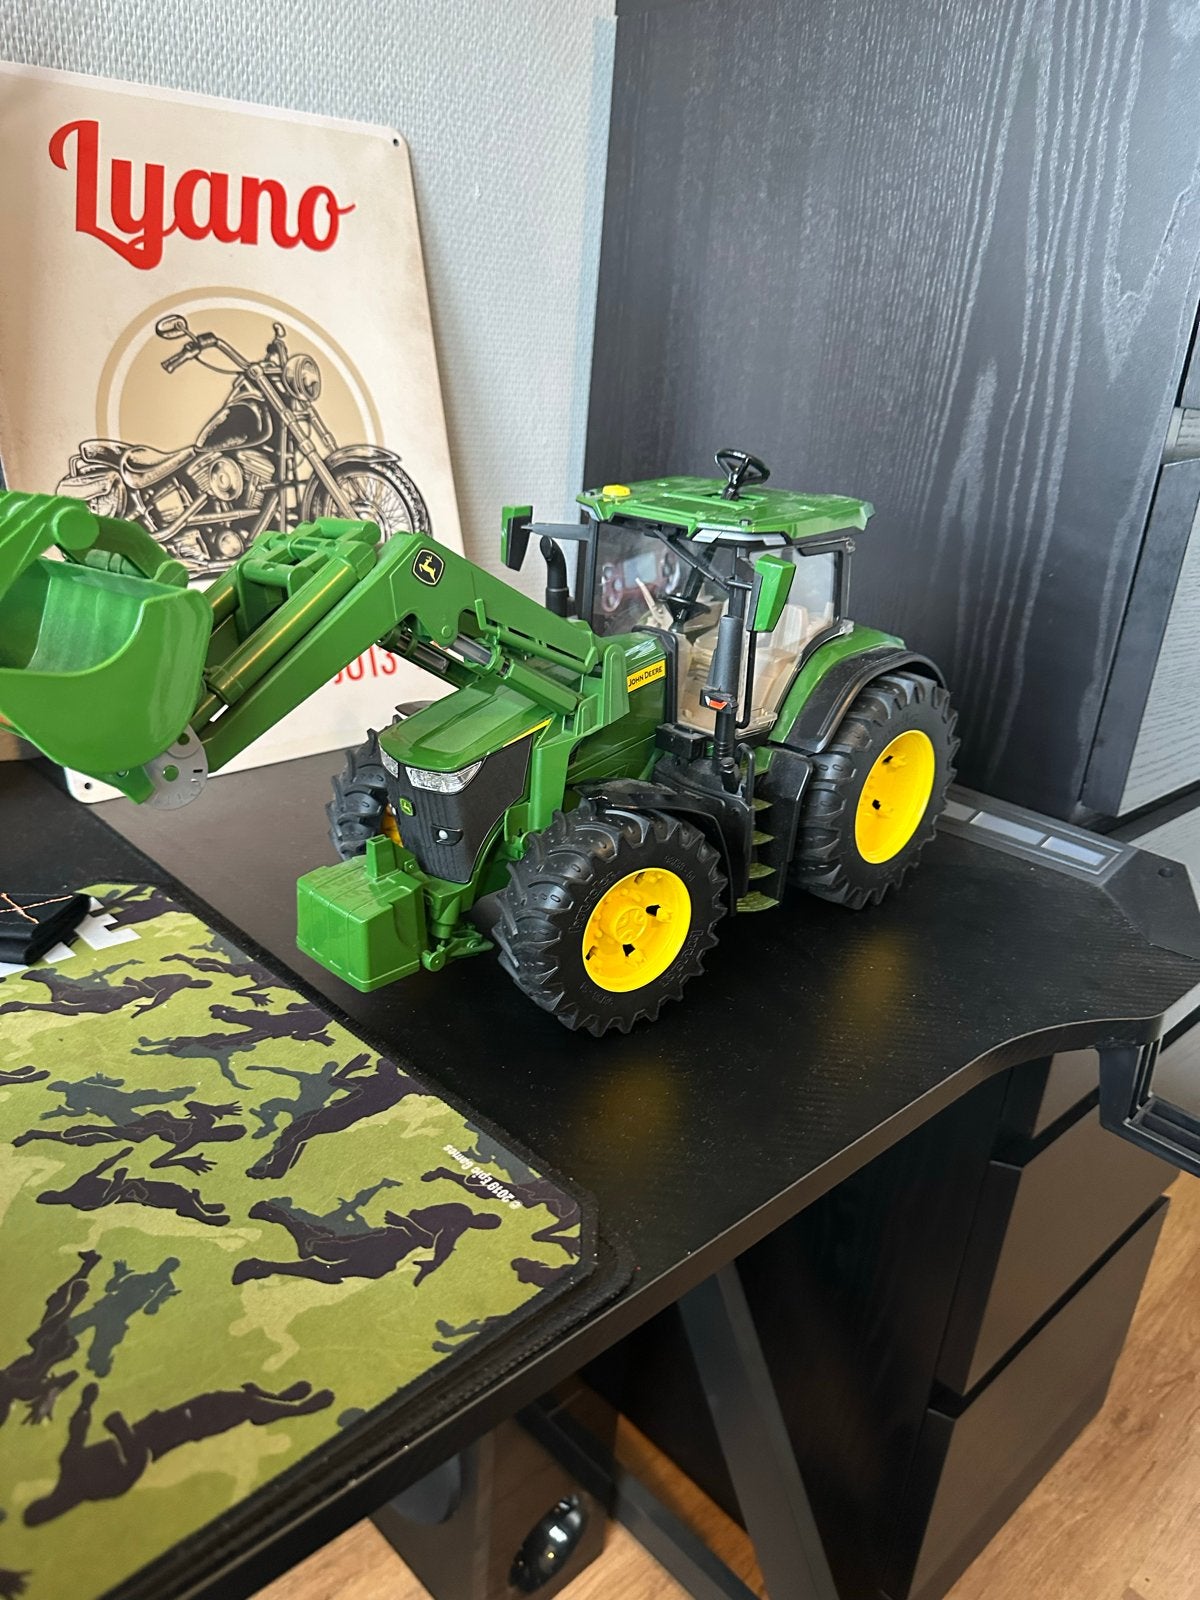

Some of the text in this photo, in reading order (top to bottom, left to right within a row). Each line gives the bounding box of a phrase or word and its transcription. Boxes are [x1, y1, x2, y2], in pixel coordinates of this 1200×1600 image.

[48, 119, 356, 270] Lyano
[628, 666, 663, 687] JOHN DEERE
[443, 1144, 474, 1170] Games
[471, 1166, 493, 1186] Epic
